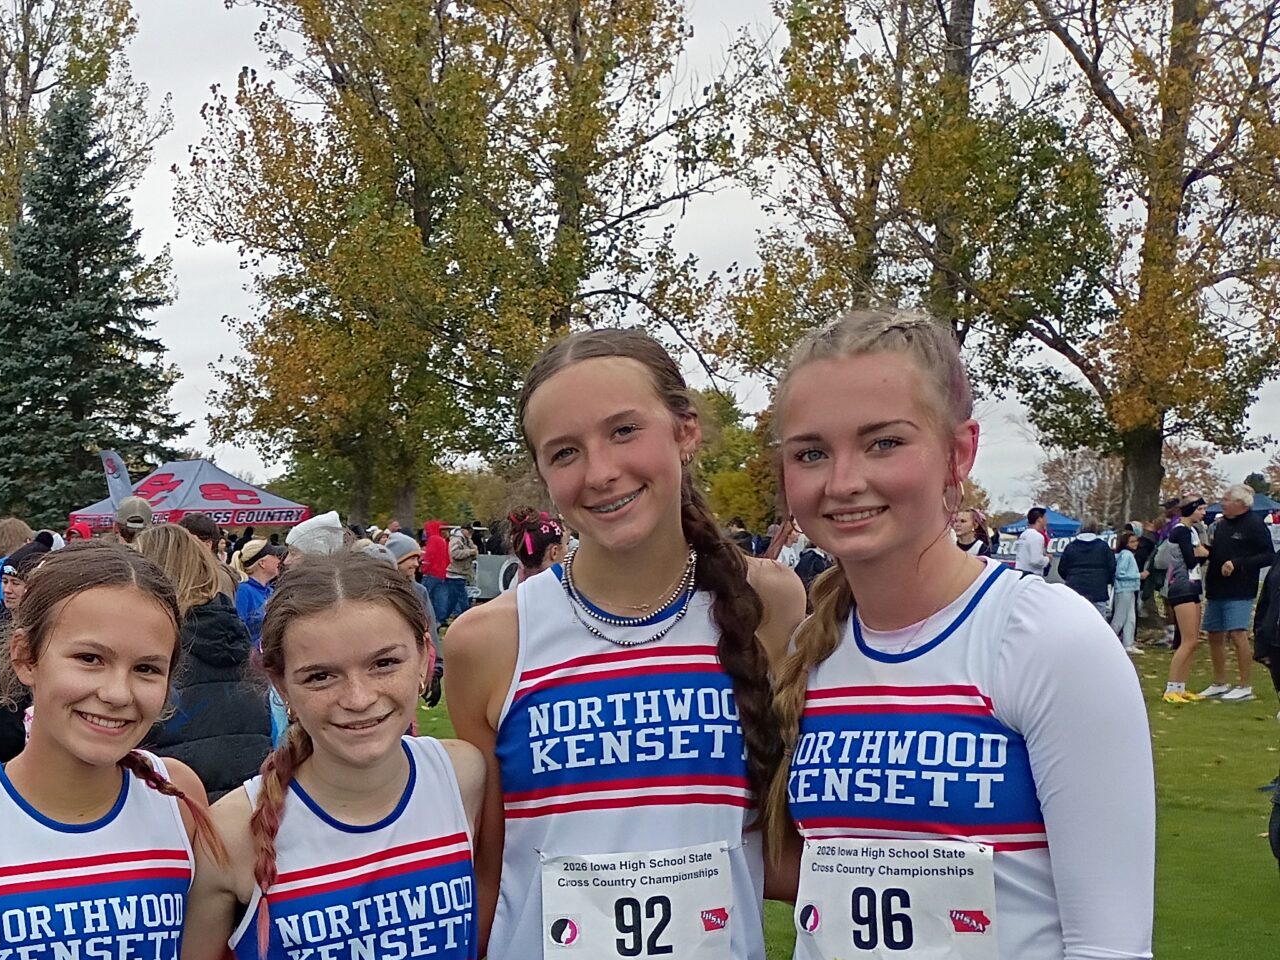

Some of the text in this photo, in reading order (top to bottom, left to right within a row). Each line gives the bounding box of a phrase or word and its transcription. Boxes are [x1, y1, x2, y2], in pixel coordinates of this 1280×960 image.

[199, 483, 262, 505] SC
[184, 509, 304, 524] OSS COUNTRY
[528, 687, 740, 738] NORTHWOO
[790, 730, 1008, 768] ORTHWOOD
[563, 852, 712, 872] 2026 Iowa High School State
[816, 845, 966, 859] 2026 Iowa High School State
[557, 867, 719, 888] Cross Country Championships
[811, 862, 974, 878] Cross Country Championships
[275, 875, 473, 948] NORTHWOOD
[851, 886, 914, 951] 96
[951, 910, 984, 932] IHSAA
[614, 895, 673, 957] 92
